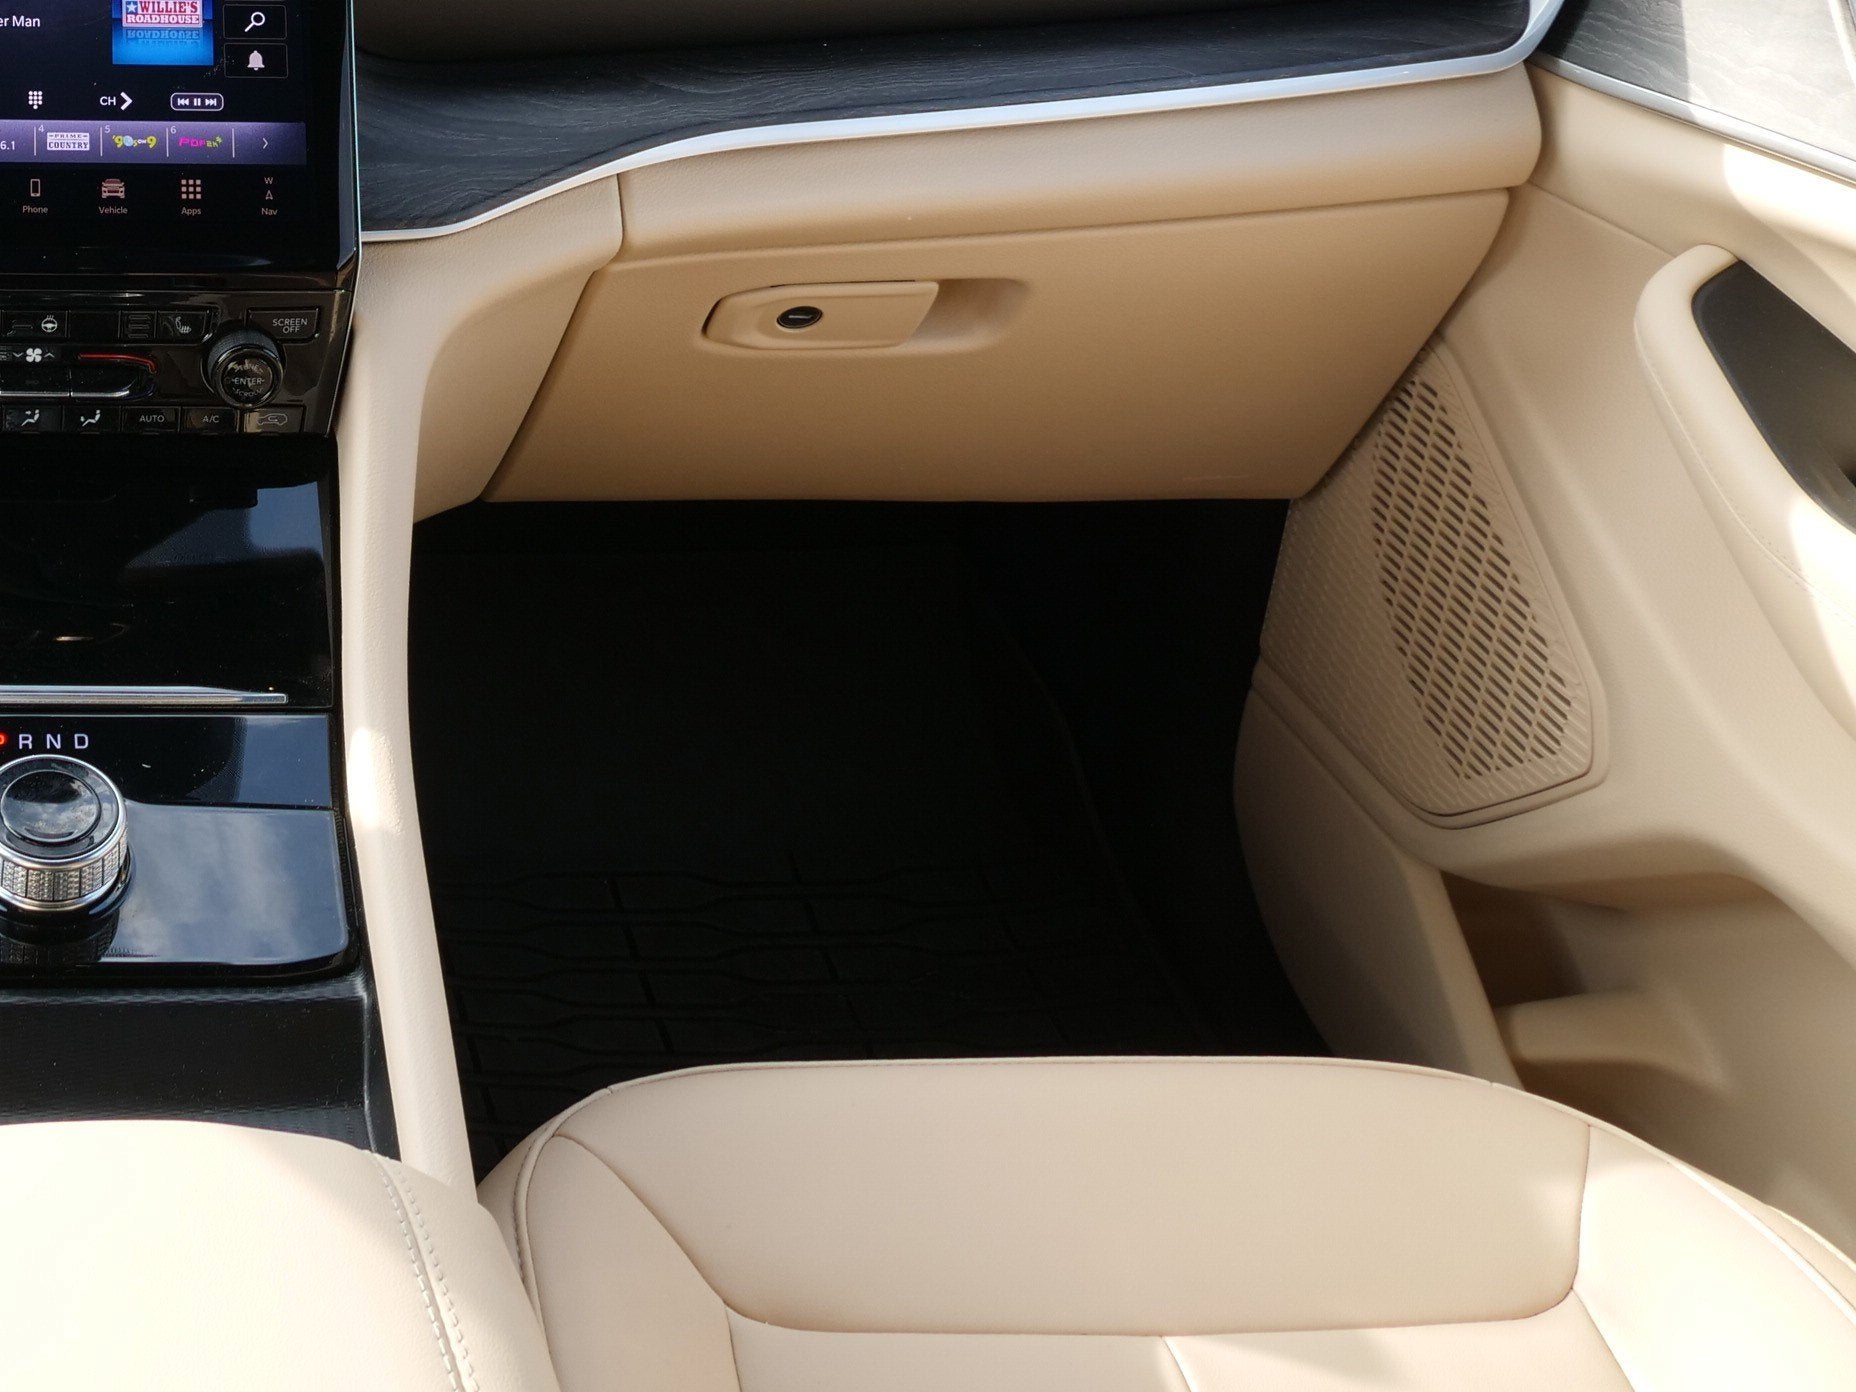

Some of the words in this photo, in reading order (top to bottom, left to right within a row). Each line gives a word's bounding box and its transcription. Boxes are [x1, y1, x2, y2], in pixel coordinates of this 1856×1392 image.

[137, 0, 199, 14] WILLIE'S
[12, 16, 41, 28] Man
[126, 14, 199, 25] ROADHOUSE
[99, 96, 116, 106] CH
[38, 125, 44, 133] 4
[104, 125, 111, 133] 5
[170, 126, 177, 134] 6
[48, 141, 89, 150] COUNTRY
[22, 205, 48, 214] Phone
[99, 206, 128, 214] Vehicle
[181, 207, 202, 217] Apps
[272, 318, 308, 327] SCREEN
[282, 326, 300, 334] OFF
[139, 414, 165, 423] AUTO
[202, 415, 219, 424] A/C
[18, 734, 33, 749] R
[46, 734, 61, 749] N
[74, 734, 89, 750] D
